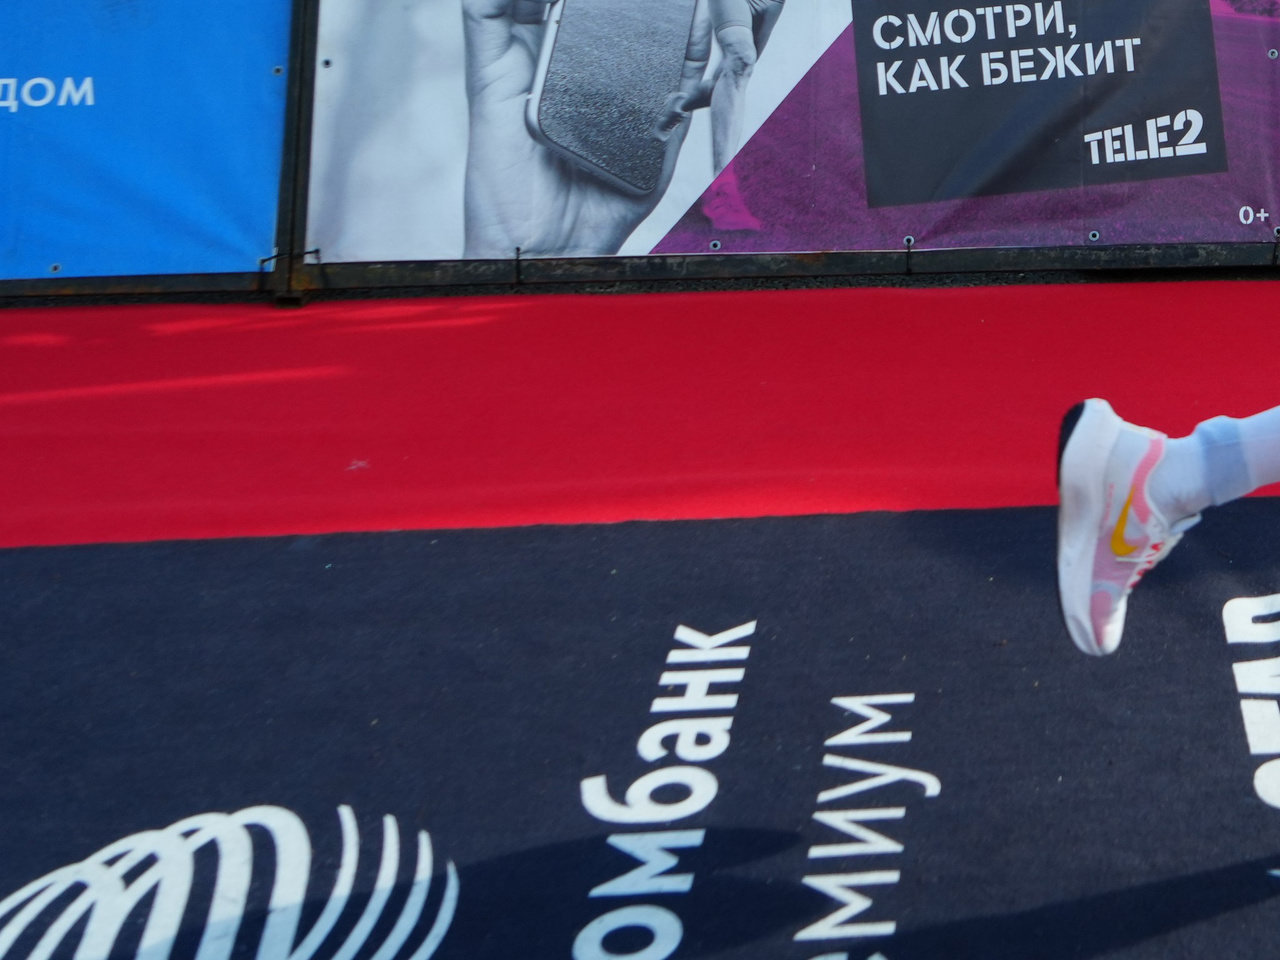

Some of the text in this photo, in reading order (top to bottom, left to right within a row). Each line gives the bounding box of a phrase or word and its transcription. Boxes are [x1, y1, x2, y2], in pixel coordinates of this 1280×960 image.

[872, 0, 1077, 50] СМОТРИ,
[876, 37, 1141, 96] КАК БЕЖИТ
[1084, 108, 1207, 166] TELE2
[1238, 205, 1270, 226] 0+
[793, 693, 941, 960] миум
